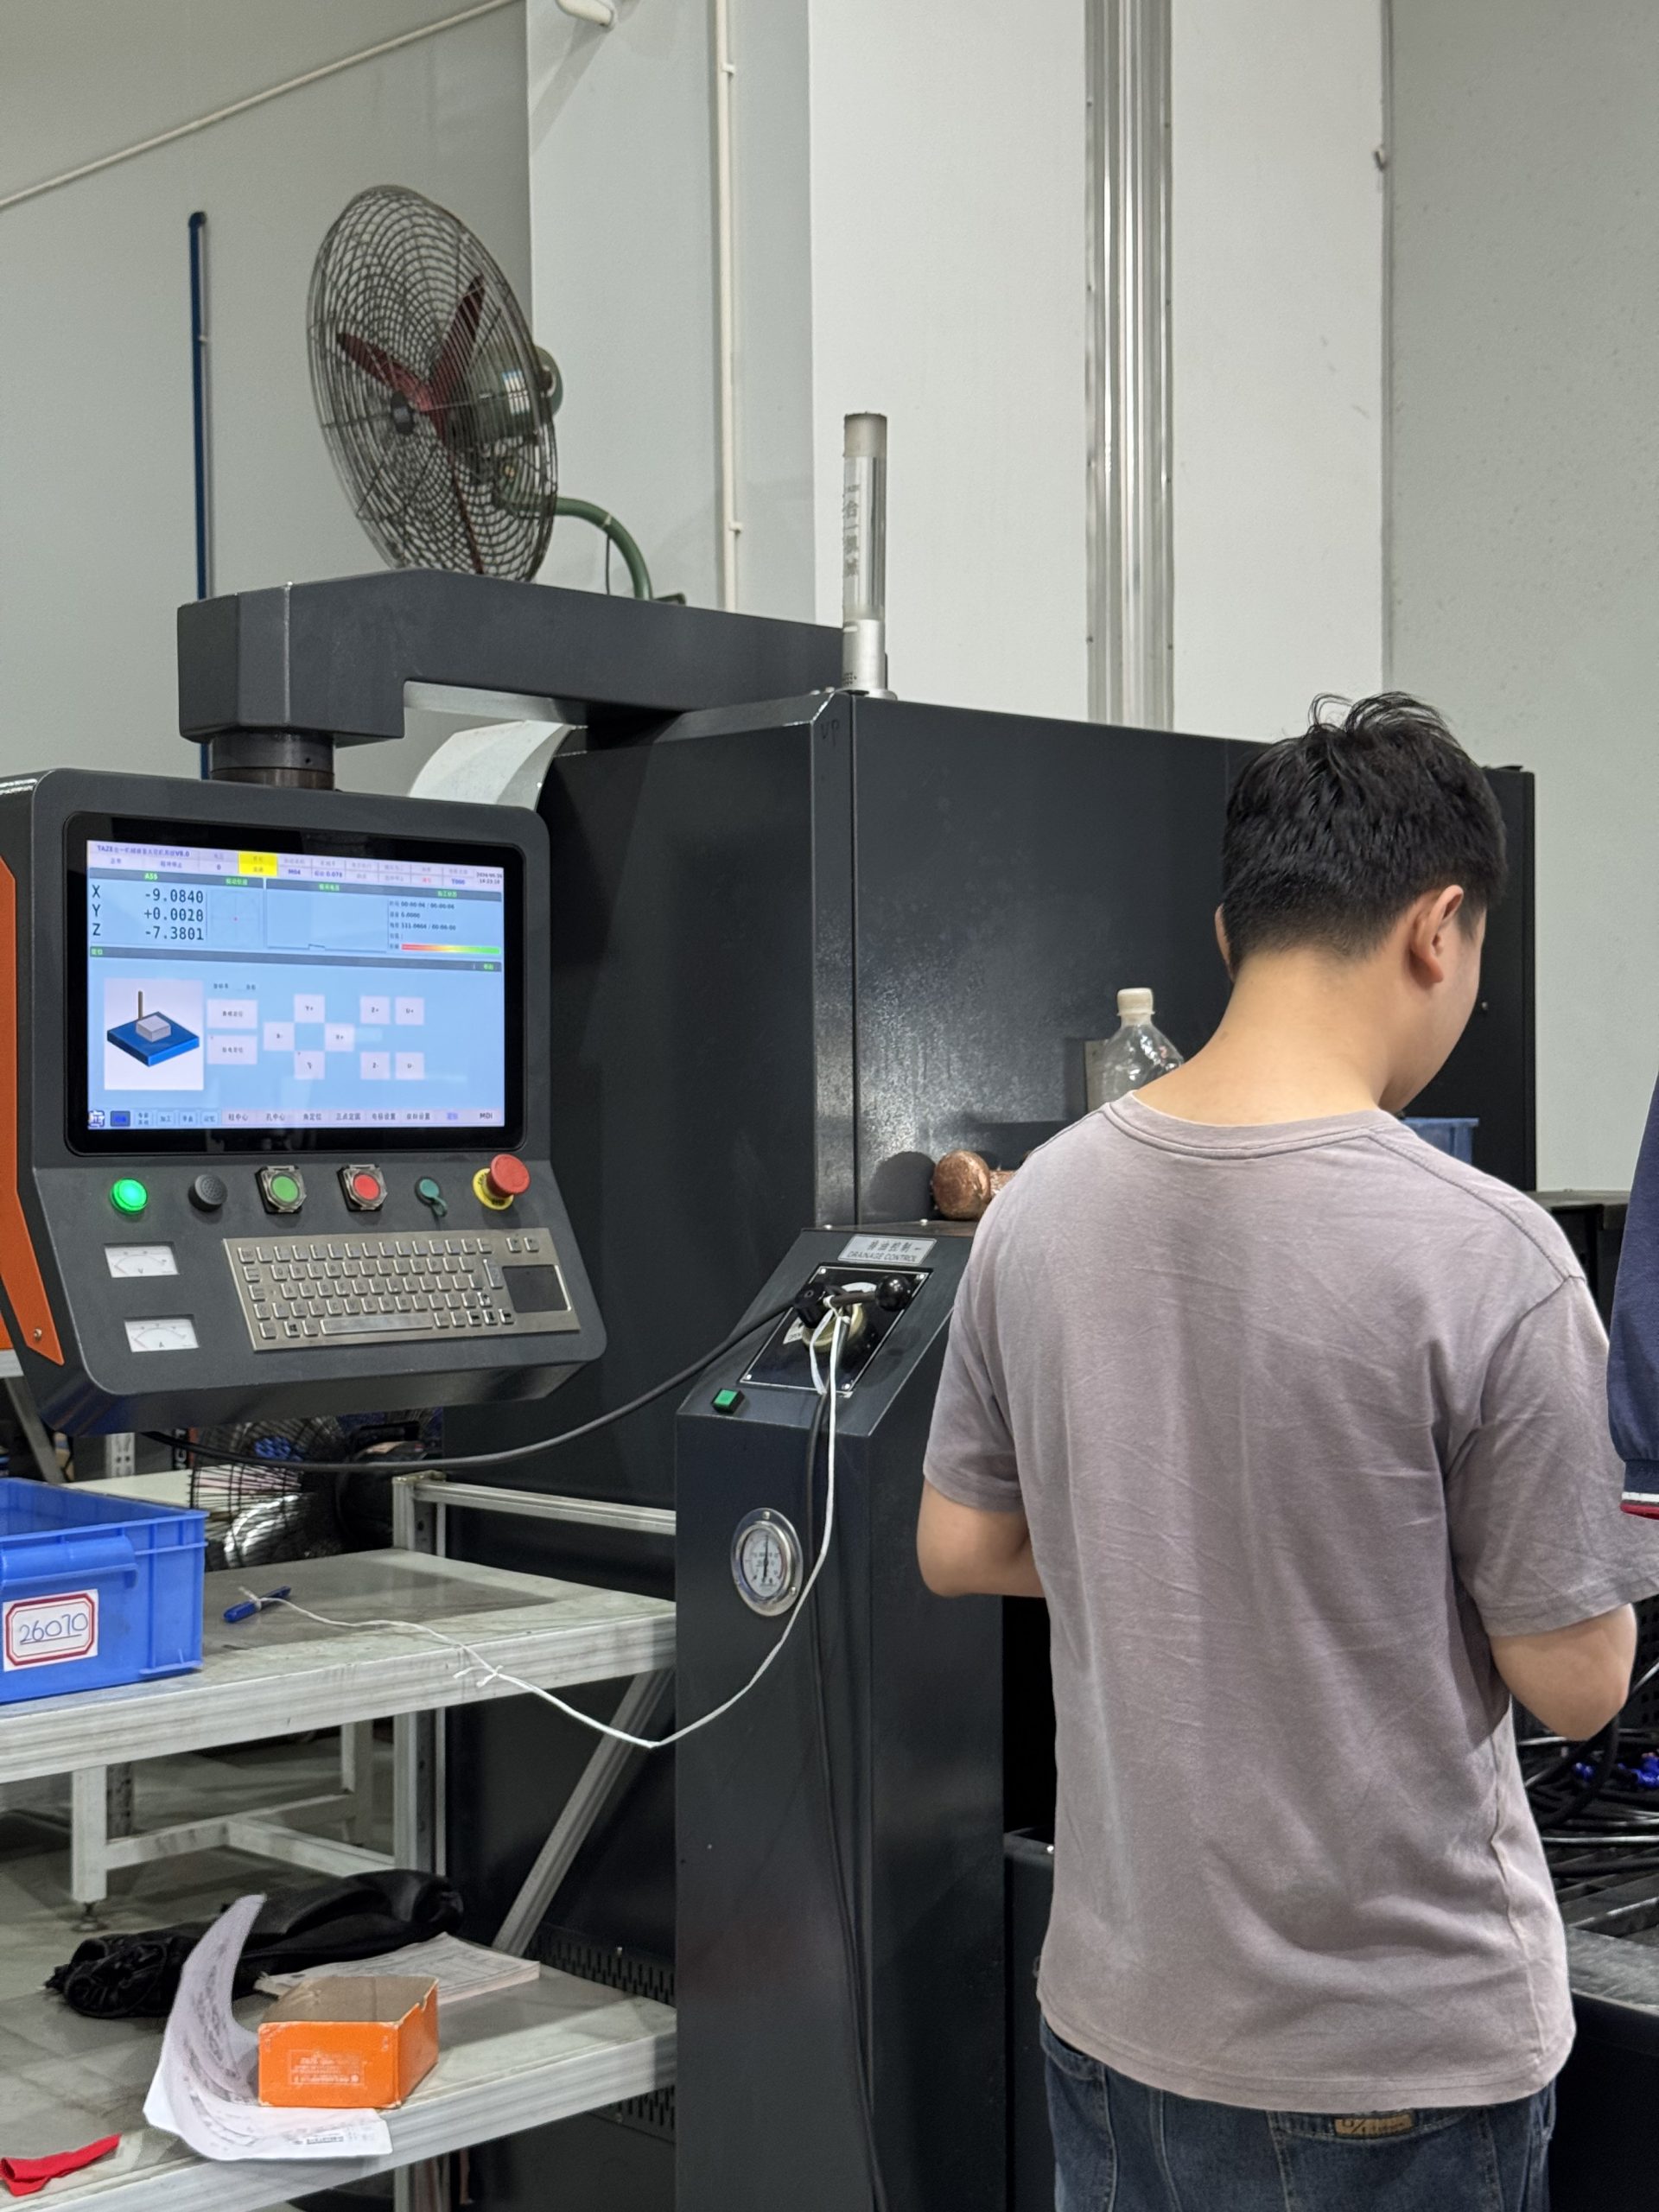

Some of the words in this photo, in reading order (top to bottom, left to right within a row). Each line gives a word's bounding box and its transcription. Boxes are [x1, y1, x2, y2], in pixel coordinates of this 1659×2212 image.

[92, 884, 101, 899] X
[145, 887, 204, 905] -9.0840
[92, 903, 101, 917] Y
[92, 923, 101, 936] Z
[145, 925, 205, 941] -7.3801
